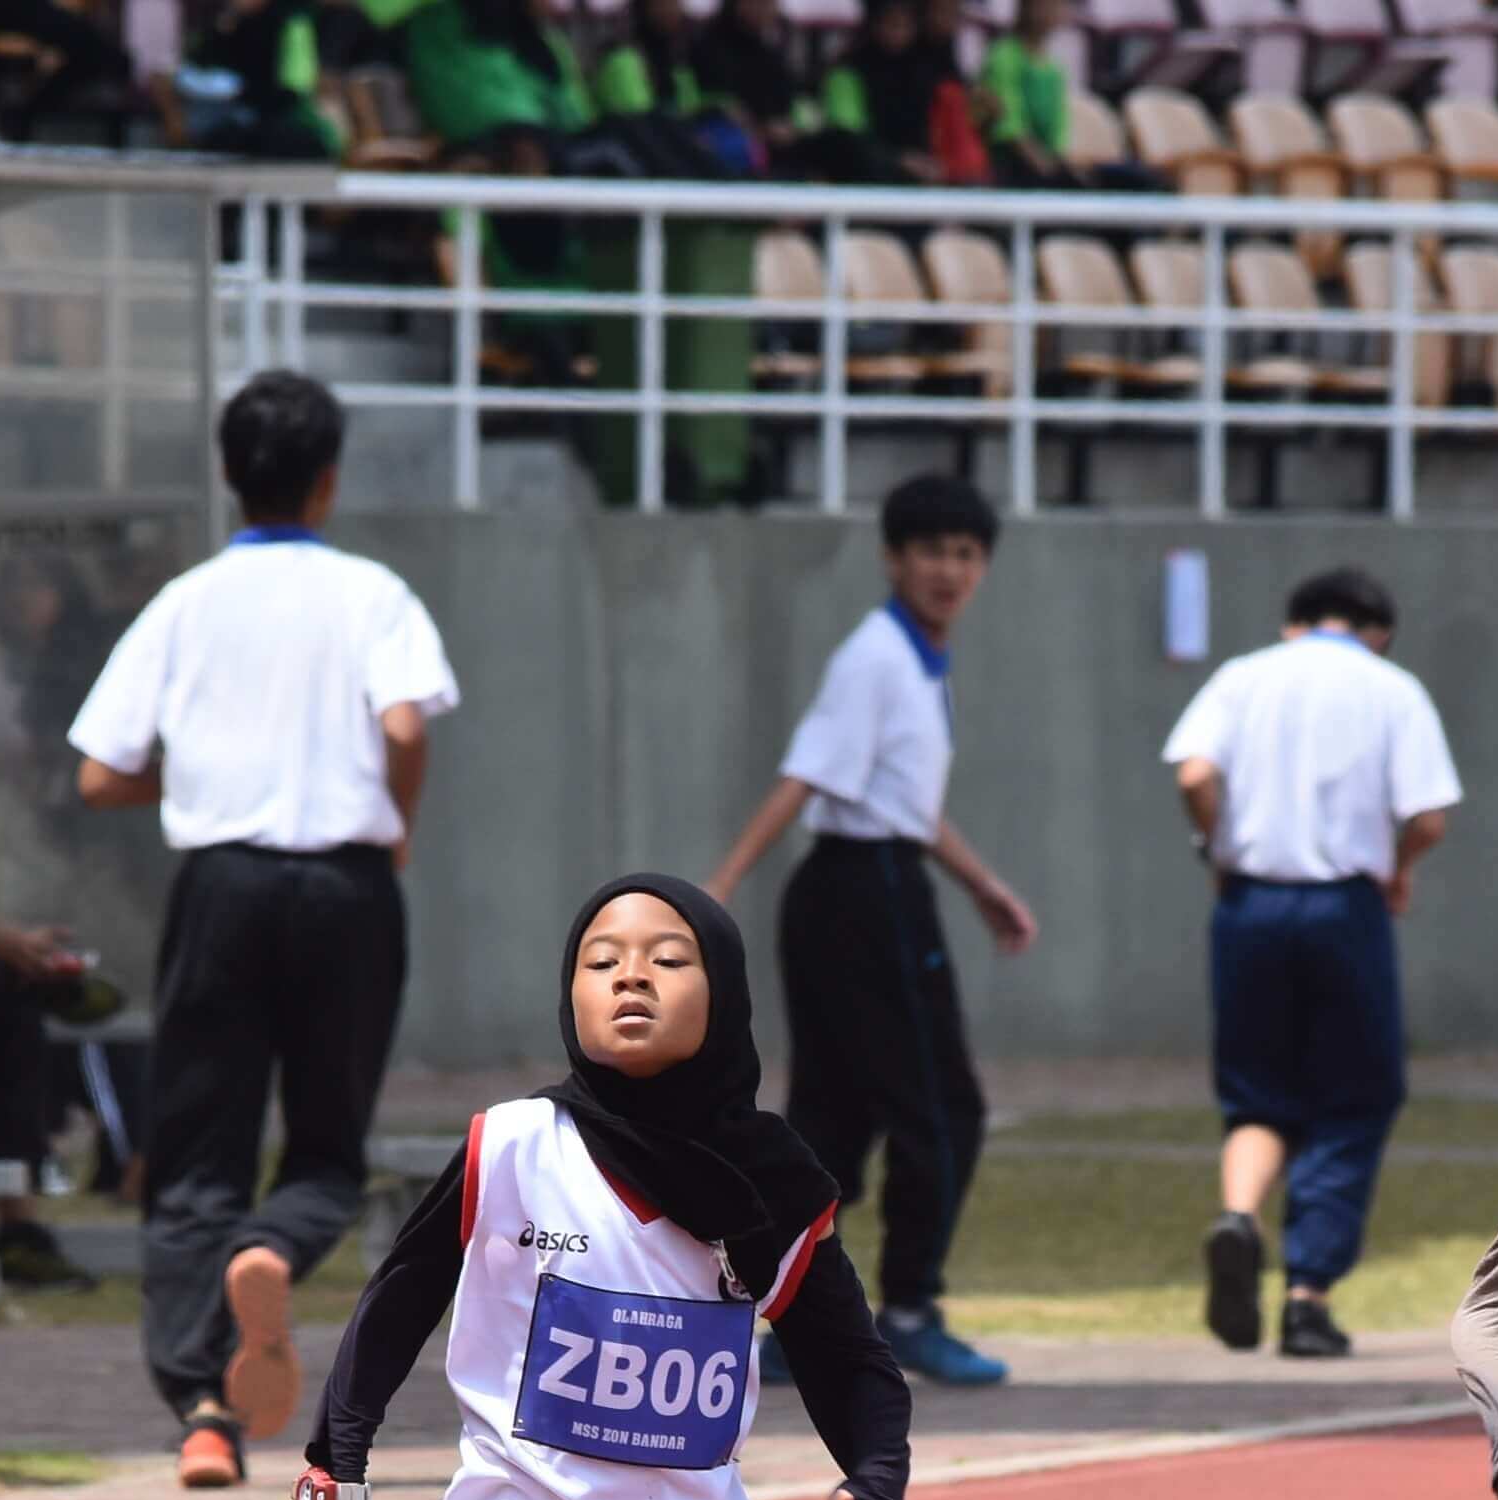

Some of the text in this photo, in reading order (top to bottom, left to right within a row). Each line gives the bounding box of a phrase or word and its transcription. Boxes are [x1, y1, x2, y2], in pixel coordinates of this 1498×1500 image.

[613, 1308, 683, 1330] OLAHRAGA
[538, 1327, 738, 1419] ZB06
[571, 1421, 686, 1450] MSS ZON BANDAR
